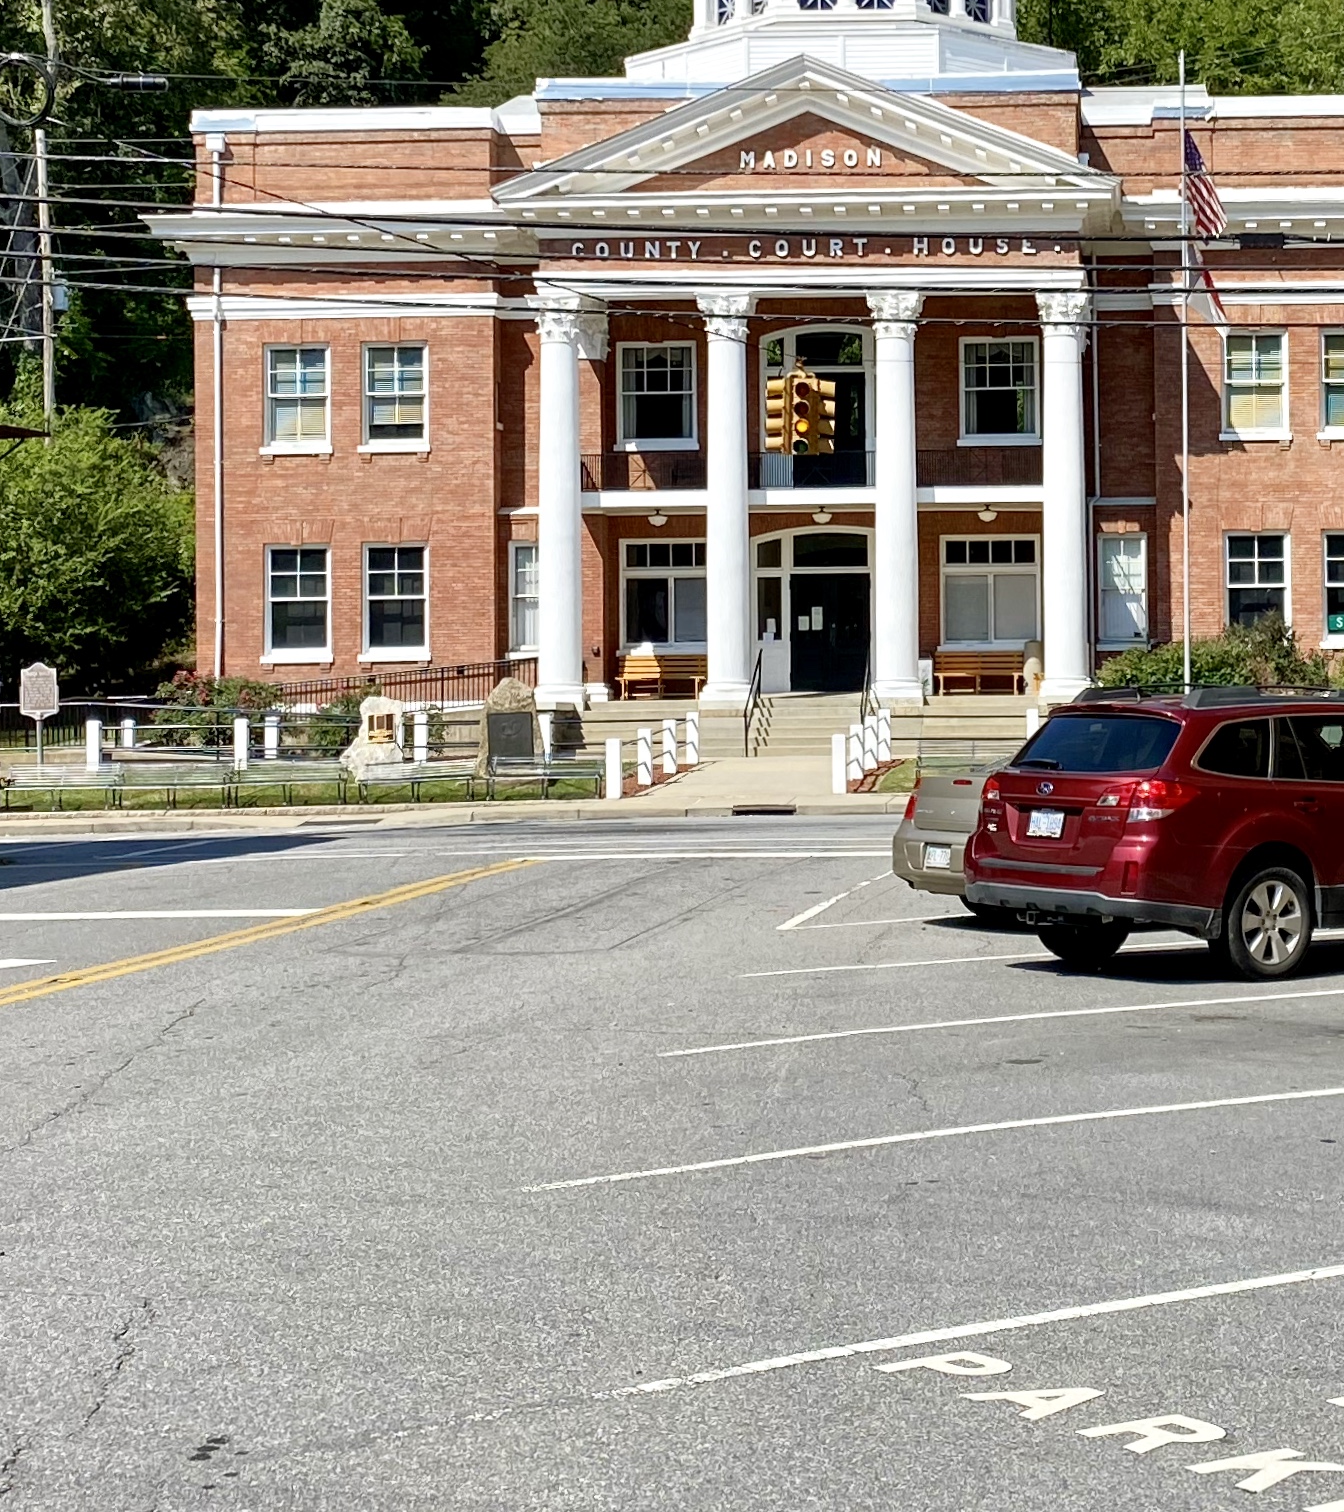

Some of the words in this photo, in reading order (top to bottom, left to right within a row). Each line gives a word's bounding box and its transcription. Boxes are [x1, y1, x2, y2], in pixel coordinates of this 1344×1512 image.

[739, 148, 882, 170] MADISON
[571, 241, 701, 259] COUNTY
[748, 238, 868, 258] COURT
[912, 237, 1037, 256] HOUSE
[1336, 616, 1344, 628] S
